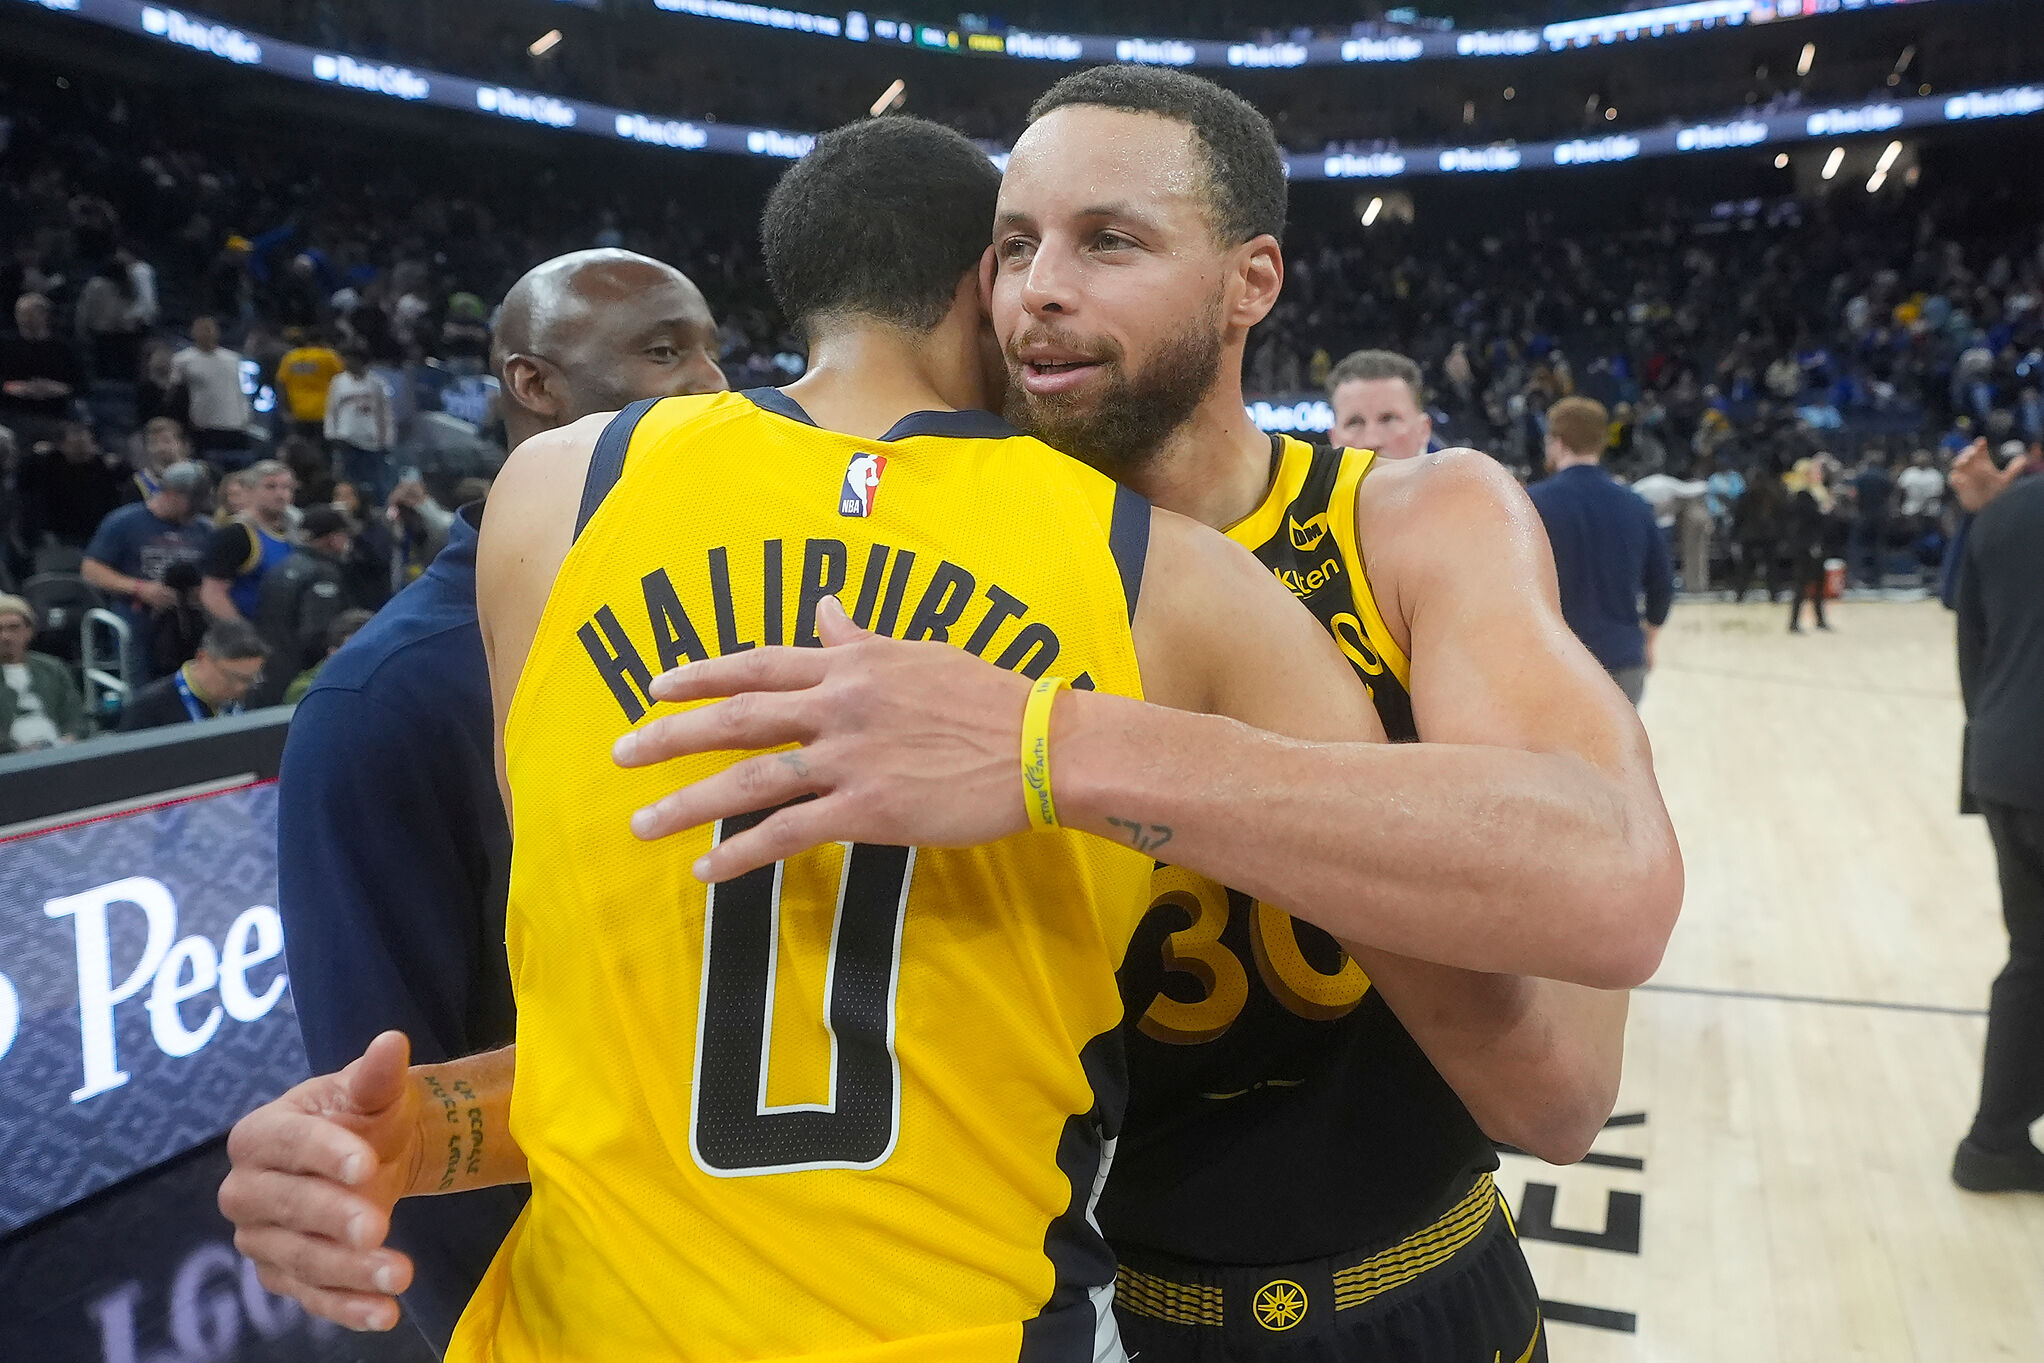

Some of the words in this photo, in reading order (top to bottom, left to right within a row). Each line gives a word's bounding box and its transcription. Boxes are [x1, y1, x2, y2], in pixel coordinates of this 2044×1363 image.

[841, 499, 860, 514] NBA
[1292, 522, 1323, 547] DM
[576, 538, 1095, 725] HALIBURTO
[688, 791, 918, 1177] 0
